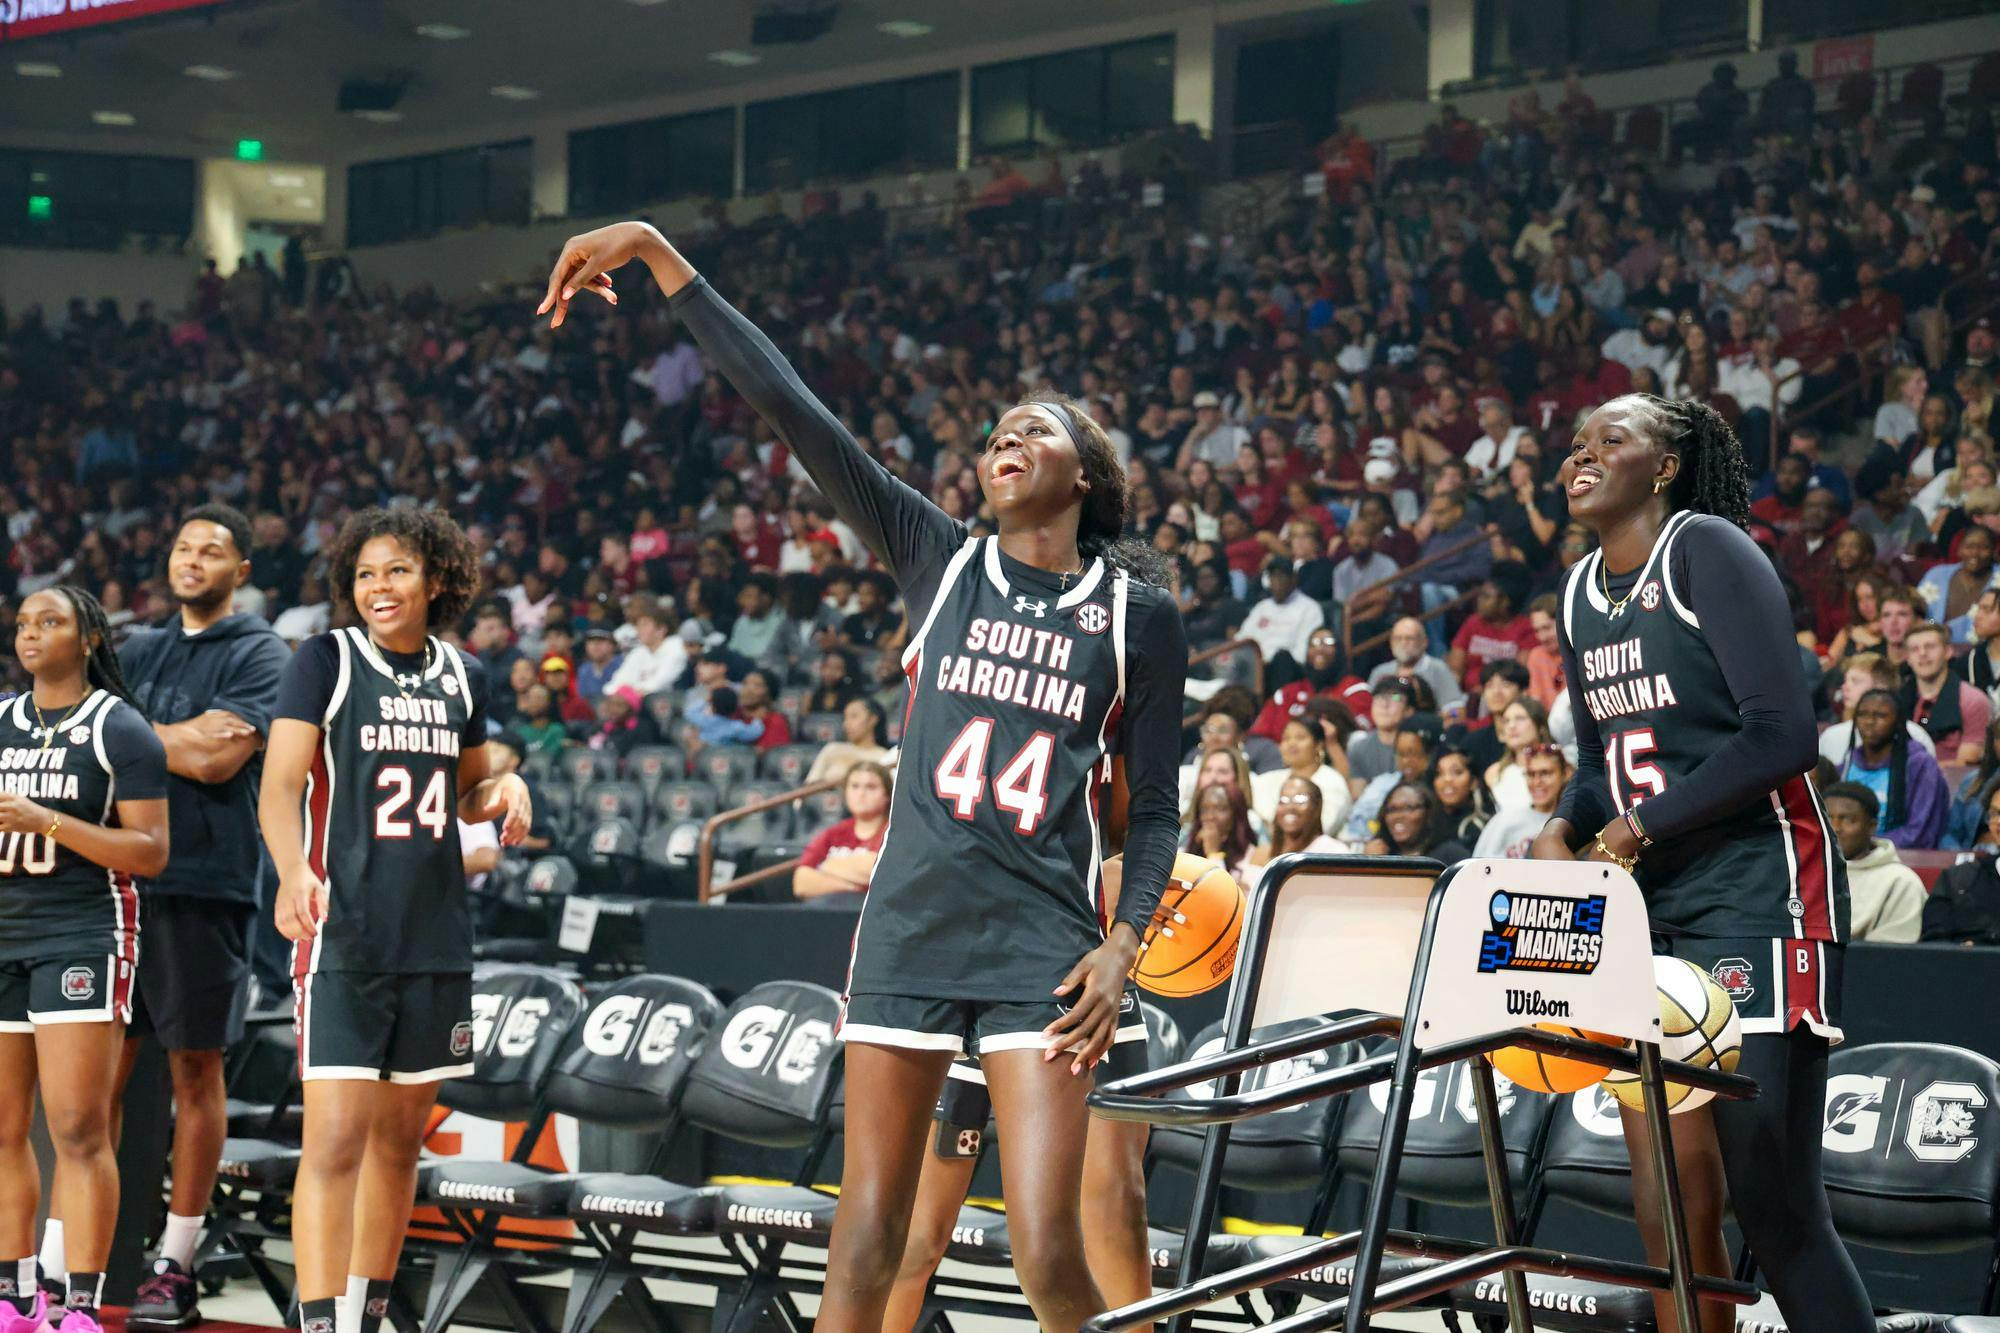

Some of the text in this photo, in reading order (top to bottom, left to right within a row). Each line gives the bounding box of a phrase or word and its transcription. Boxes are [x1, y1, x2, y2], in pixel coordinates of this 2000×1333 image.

[1641, 581, 1659, 610] SEC
[1077, 604, 1107, 632] SEC
[966, 618, 1073, 671] SOUTH
[1583, 637, 1643, 682] SOUTH
[936, 655, 1087, 722] CAROLINA
[379, 695, 448, 725] SOUTH
[360, 724, 460, 758] CAROLINA
[1, 747, 67, 770] SOUTH
[1604, 728, 1667, 818] 15
[935, 715, 1056, 837] 44
[374, 765, 449, 840] 24
[1508, 897, 1574, 930] MARCH
[1515, 929, 1601, 963] MADNESS
[1795, 948, 1809, 974] B
[1505, 989, 1569, 1017] Wilson
[1822, 1074, 1887, 1153] G
[581, 1195, 664, 1218] GAMECOCKS
[727, 1204, 813, 1229] GAMECOCKS
[1474, 1281, 1597, 1316] GACOCKS
